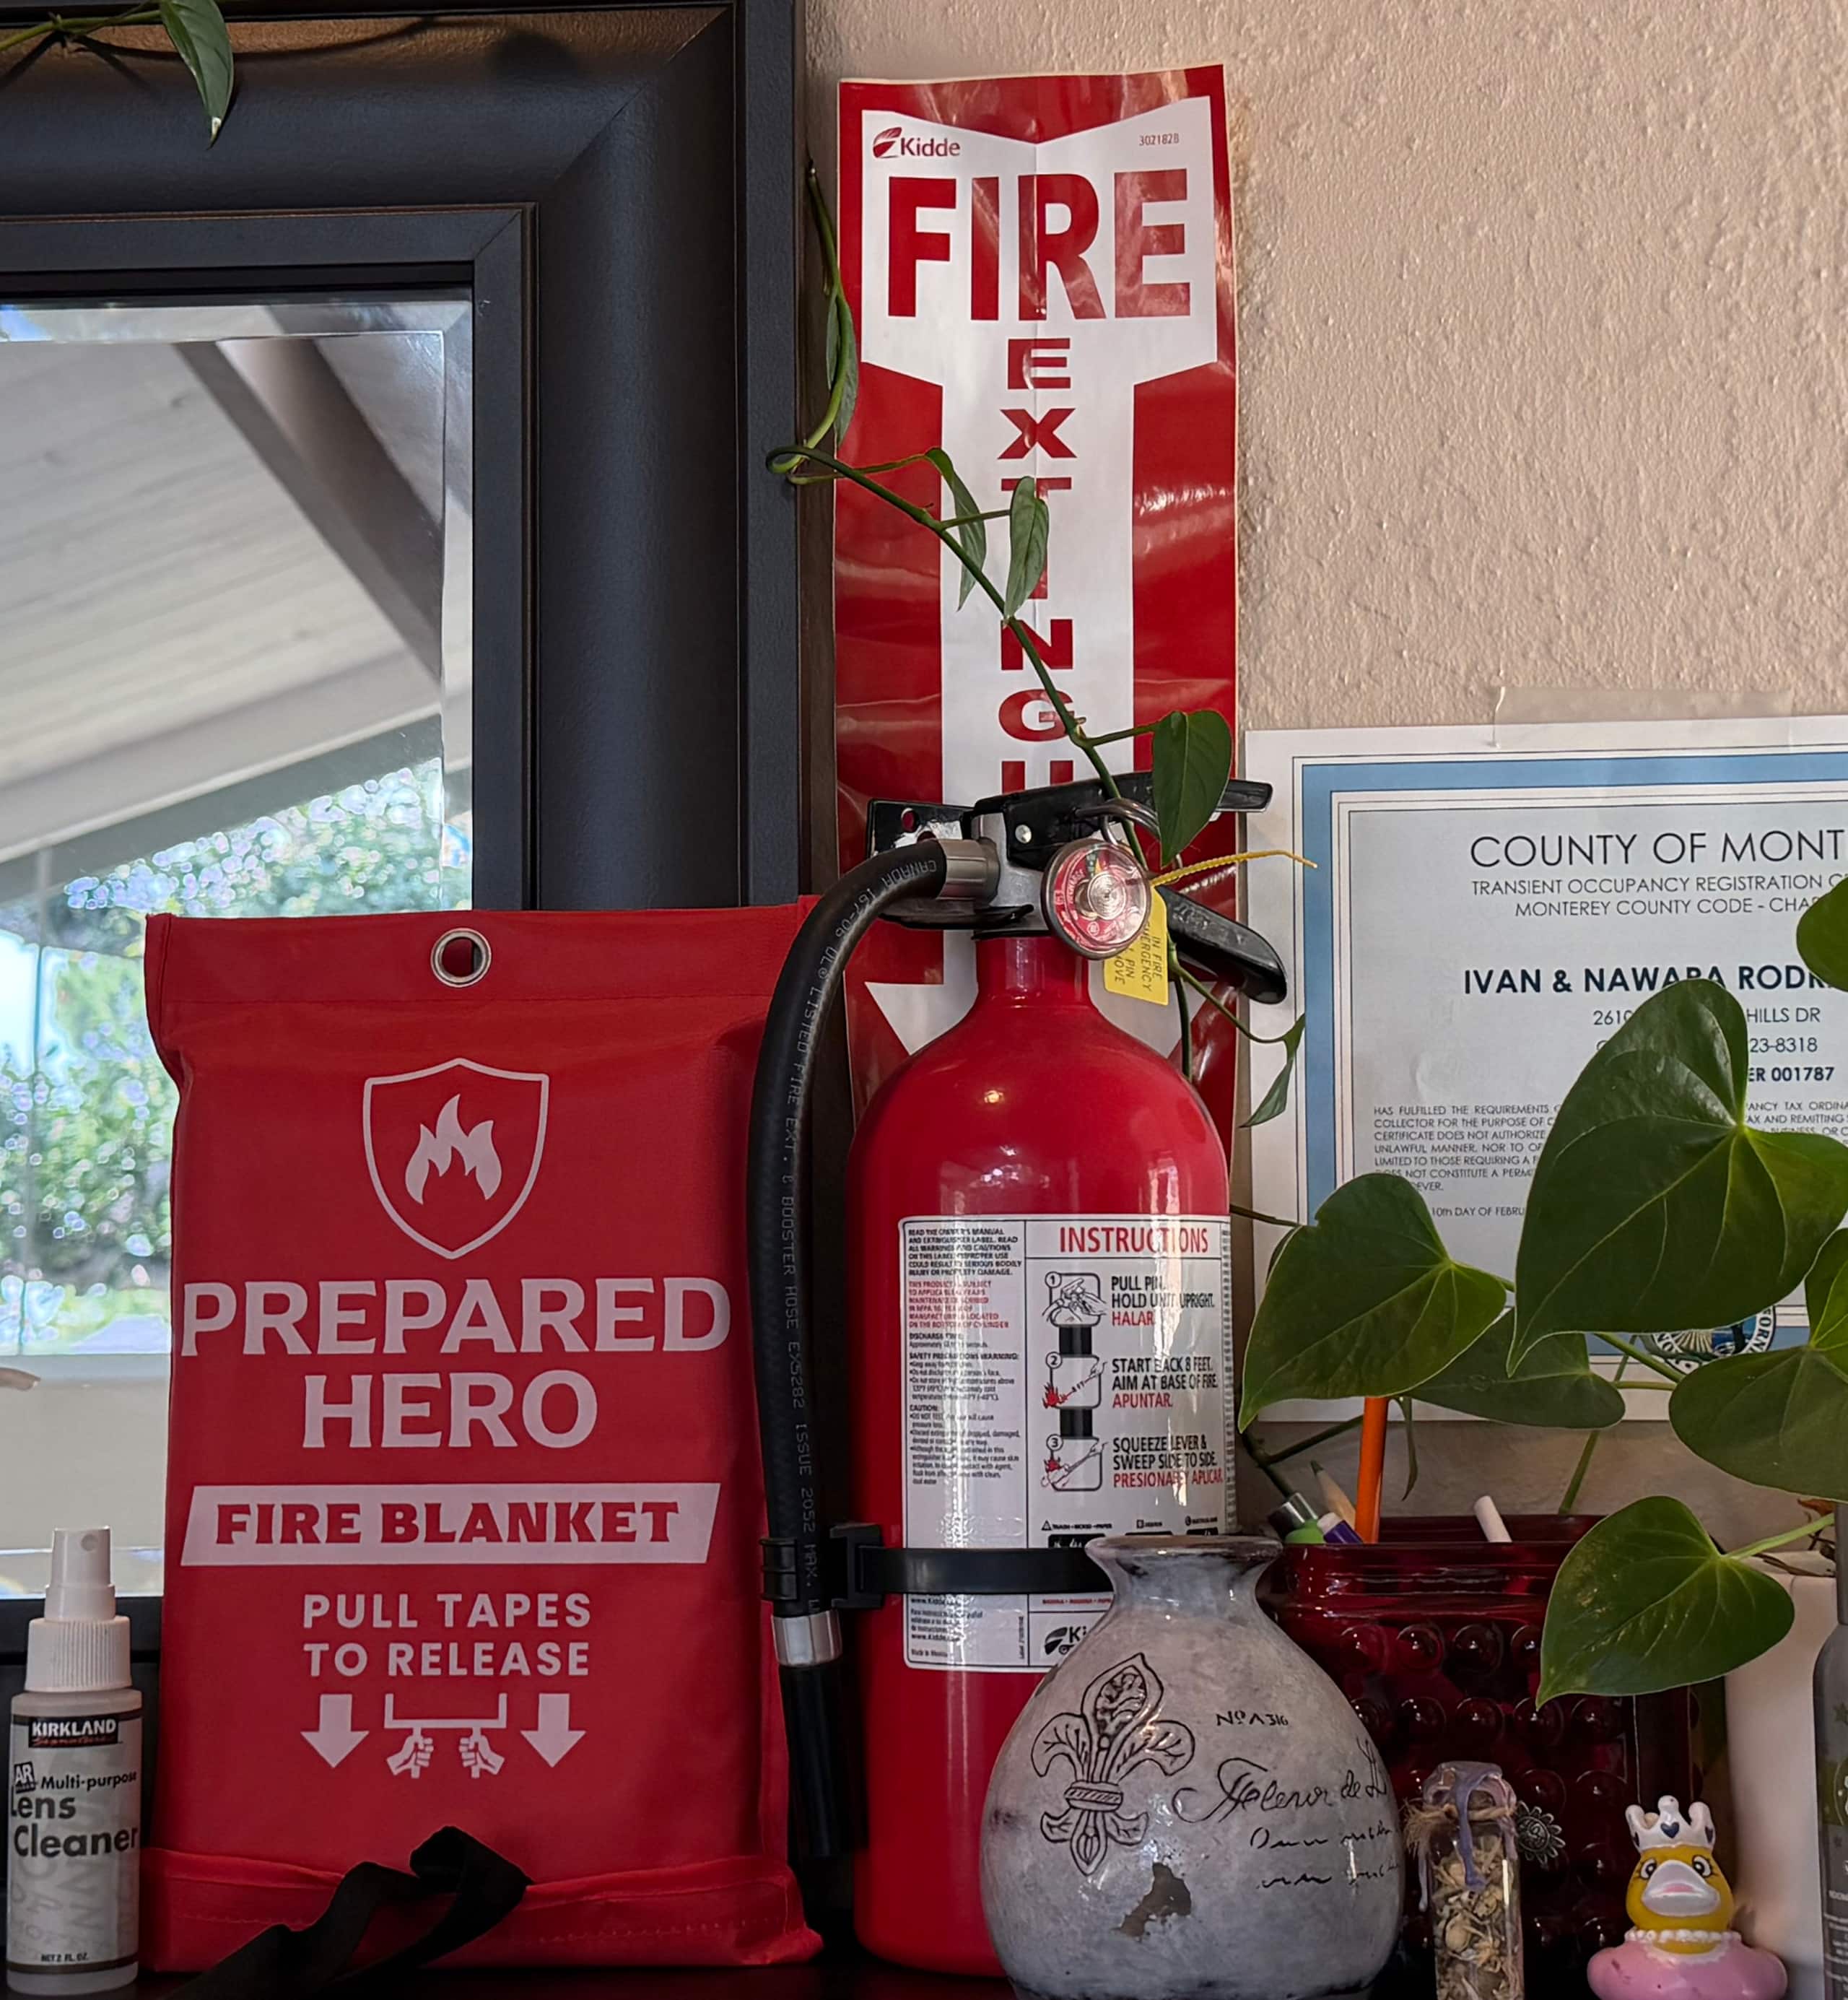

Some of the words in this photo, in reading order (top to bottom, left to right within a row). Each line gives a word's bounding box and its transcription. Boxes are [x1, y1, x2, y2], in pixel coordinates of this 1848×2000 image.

[900, 136, 961, 158] Kidde
[887, 168, 1191, 322] FIRE
[1470, 834, 1637, 867] COUNTY
[1653, 832, 1707, 864] OF
[1472, 879, 1563, 895] TRANSIENT
[1568, 877, 1690, 894] OCCUPANCY
[1696, 874, 1822, 892] REGISTRATION
[1516, 901, 1611, 916] MONTEREY
[1616, 900, 1691, 915] COUNTY
[1697, 898, 1753, 913] CODE
[1465, 969, 1541, 994] IVAN
[1552, 970, 1572, 993] &
[1796, 1007, 1821, 1022] DR
[1771, 1066, 1834, 1082] 001787
[788, 1062, 806, 1105] FIRE
[1374, 1105, 1393, 1116] HAS
[1399, 1105, 1446, 1116] FULFILLED
[1452, 1105, 1469, 1115] THE
[1474, 1104, 1549, 1115] REQUIREMENTS
[1784, 1101, 1803, 1110] TAX
[1374, 1118, 1434, 1128] COLLECTOR
[1437, 1118, 1458, 1128] FOR
[1461, 1118, 1478, 1127] THE
[1481, 1117, 1527, 1127] PURPOSE
[1529, 1117, 1543, 1126] OF
[1764, 1115, 1787, 1123] AND
[1790, 1114, 1845, 1123] REMITTING
[1374, 1131, 1434, 1141] CERTIFICATE
[1437, 1131, 1465, 1140] DOES
[1468, 1131, 1489, 1140] NOT
[1491, 1130, 1546, 1140] AUTHORIZE
[1374, 1144, 1427, 1154] UNLAWFUL
[1482, 1143, 1506, 1152] NOR
[1510, 1143, 1524, 1152] TO
[1374, 1156, 1412, 1166] LIMITED
[1413, 1156, 1428, 1165] TO
[1430, 1156, 1461, 1165] THOSE
[1464, 1155, 1520, 1165] REQUIRING
[1522, 1155, 1530, 1165] A
[1405, 1169, 1427, 1178] NOT
[1429, 1168, 1488, 1178] CONSTITUTE
[1491, 1168, 1499, 1178] A
[1455, 1206, 1477, 1216] DAY
[1478, 1206, 1493, 1216] OF
[1495, 1206, 1525, 1216] FEBRU
[781, 1196, 796, 1277] BOOSTER
[1060, 1226, 1208, 1253] INSTRUCTIONS
[1111, 1275, 1141, 1290] PULL
[785, 1285, 799, 1329] HOSE
[1112, 1292, 1146, 1308] HOLD
[181, 1277, 731, 1357] PREPARED
[1112, 1358, 1151, 1373] START
[1112, 1375, 1138, 1391] AIM
[1141, 1375, 1156, 1390] AT
[1160, 1374, 1187, 1390] BASE
[302, 1370, 598, 1449] HERO
[1112, 1436, 1167, 1453] SQUEEZE
[1200, 1435, 1207, 1450] &
[1113, 1455, 1155, 1471] SWEEP
[1185, 1453, 1198, 1467] TO
[215, 1502, 363, 1546] FIRE
[380, 1500, 679, 1544] BLANKET
[303, 1594, 419, 1630] PULL
[436, 1593, 591, 1628] TAPES
[303, 1643, 367, 1677] TO
[388, 1642, 590, 1677] RELEASE
[32, 1719, 116, 1736] KIRKLAND
[15, 1763, 34, 1784] AR
[14, 1823, 139, 1857] Cleaner
